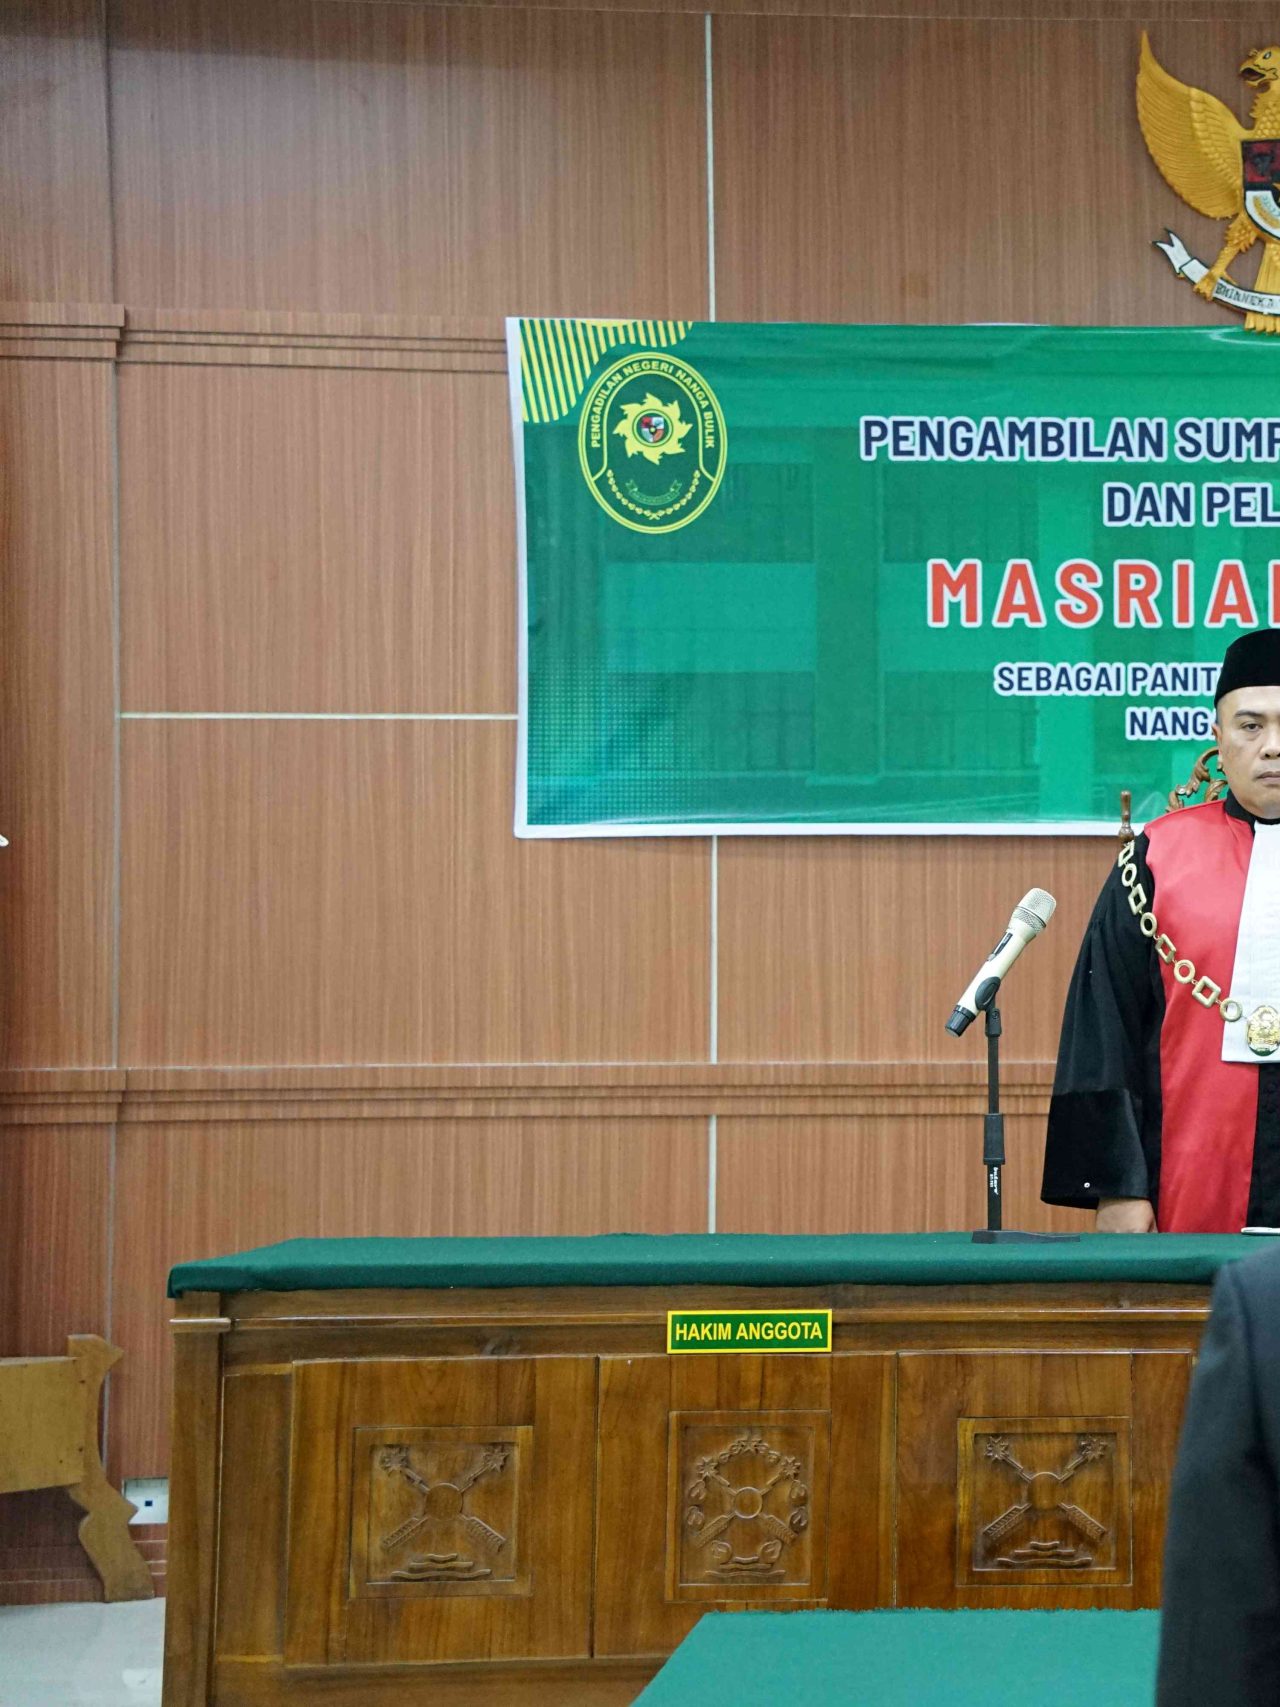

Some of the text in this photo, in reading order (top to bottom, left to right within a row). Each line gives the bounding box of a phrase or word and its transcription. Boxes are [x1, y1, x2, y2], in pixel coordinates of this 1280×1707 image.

[590, 360, 715, 449] PENGADILAN NEGERI NANGA BULIK
[862, 418, 1165, 459] PENGAMBILAN
[1106, 485, 1192, 524] DAN
[997, 665, 1122, 693] SEBAGAI
[1131, 665, 1219, 693] PANIT
[1129, 709, 1216, 737] NANG
[675, 1321, 823, 1341] HAKIM ANGGOTA
